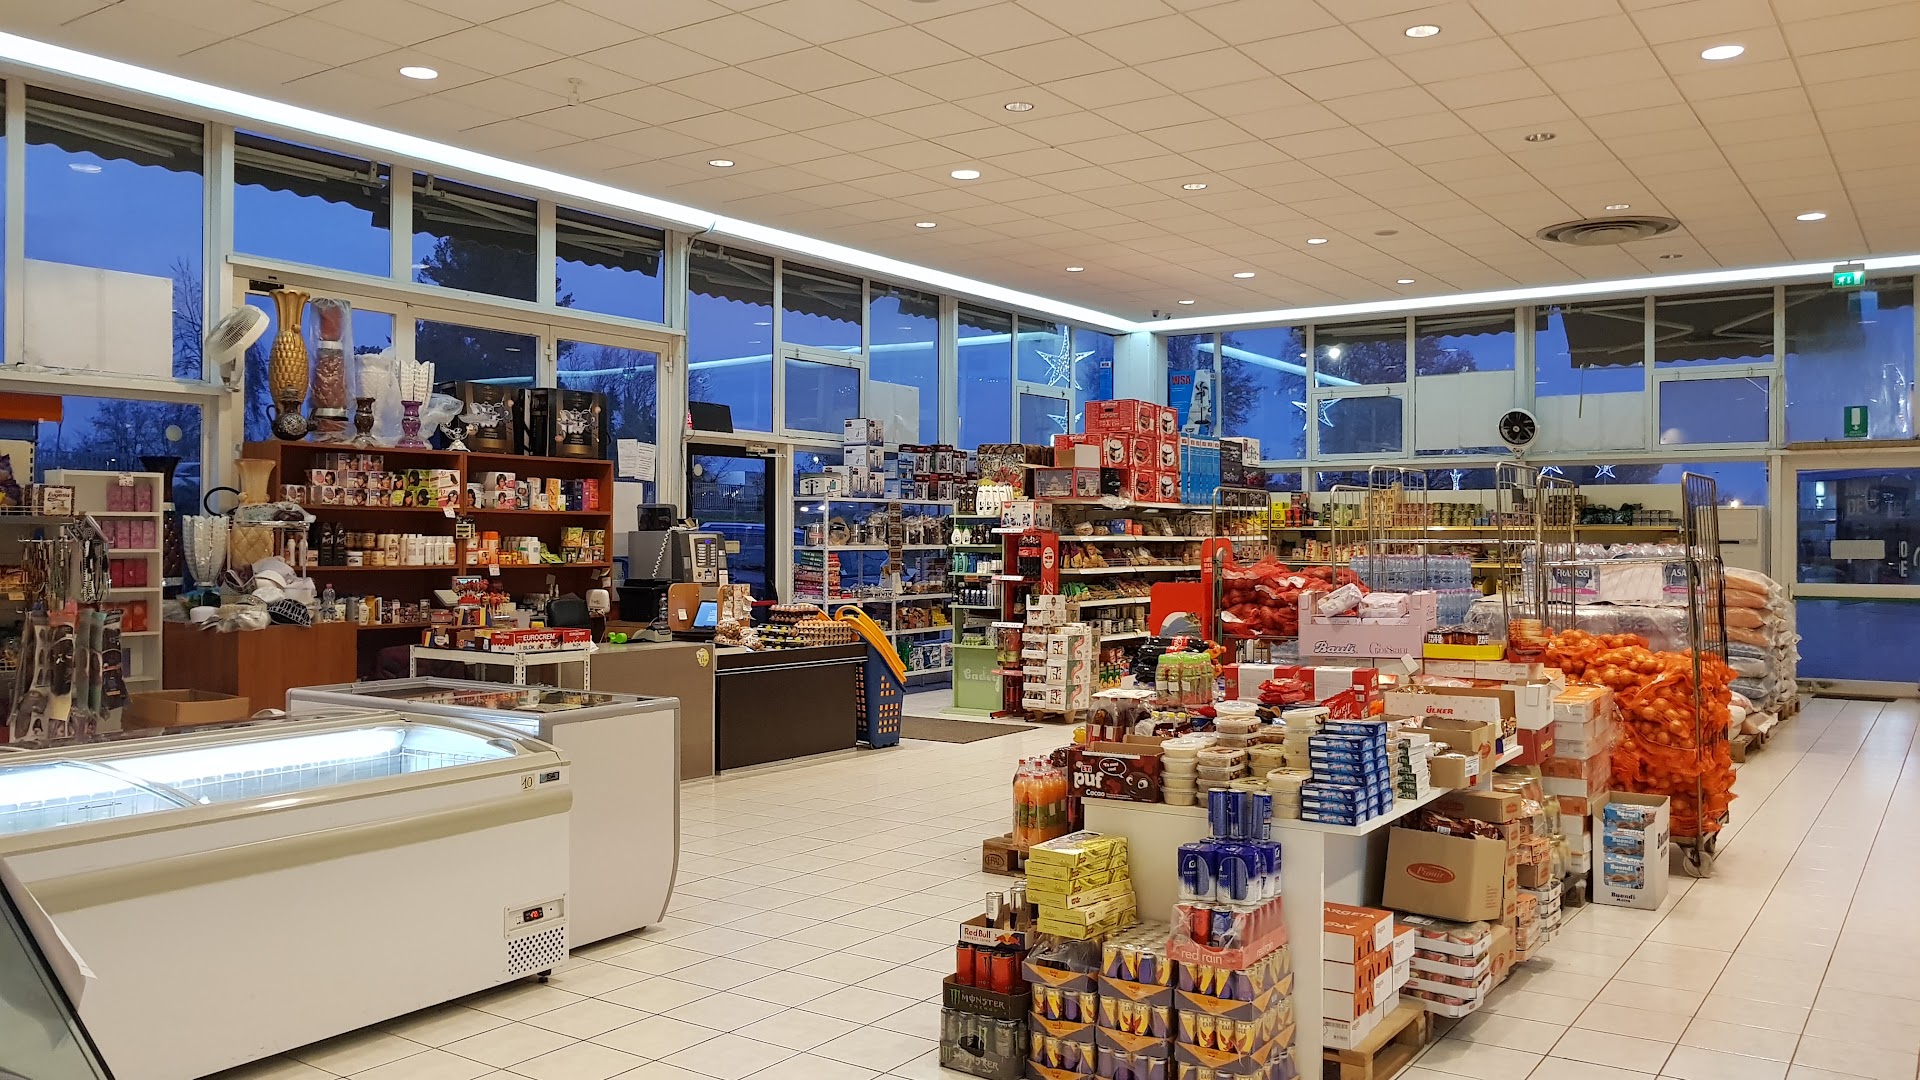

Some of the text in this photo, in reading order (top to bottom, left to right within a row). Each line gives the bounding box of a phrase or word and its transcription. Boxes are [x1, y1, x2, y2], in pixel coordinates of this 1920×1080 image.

[522, 632, 556, 641] EUROCREM
[1314, 641, 1356, 654] Bauli
[1426, 705, 1454, 715] ÜLKER
[521, 776, 533, 790] 10
[1073, 771, 1104, 789] puf
[1085, 788, 1106, 797] Cacao
[964, 927, 991, 939] Red Bull
[1181, 949, 1223, 965] red rain
